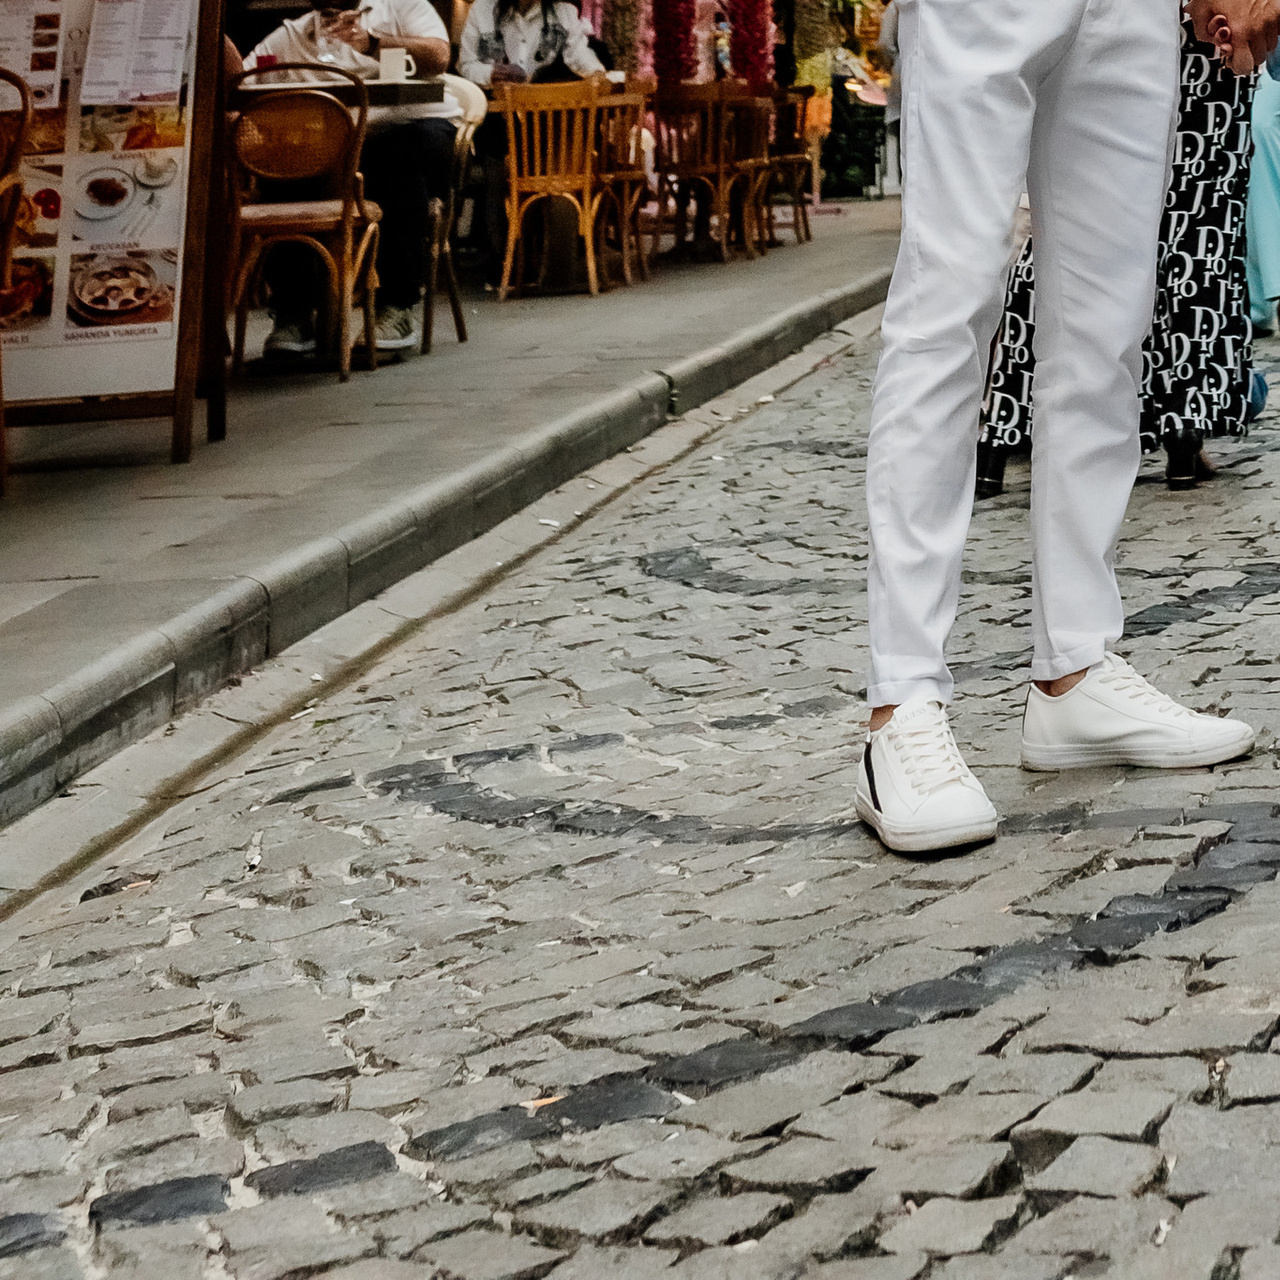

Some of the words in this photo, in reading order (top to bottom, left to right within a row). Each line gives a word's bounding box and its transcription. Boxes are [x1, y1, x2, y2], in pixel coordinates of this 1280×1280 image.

[1181, 53, 1211, 112] Dior
[1172, 131, 1205, 191] Dior
[1192, 226, 1227, 287] Dior
[1001, 311, 1030, 374] Dior
